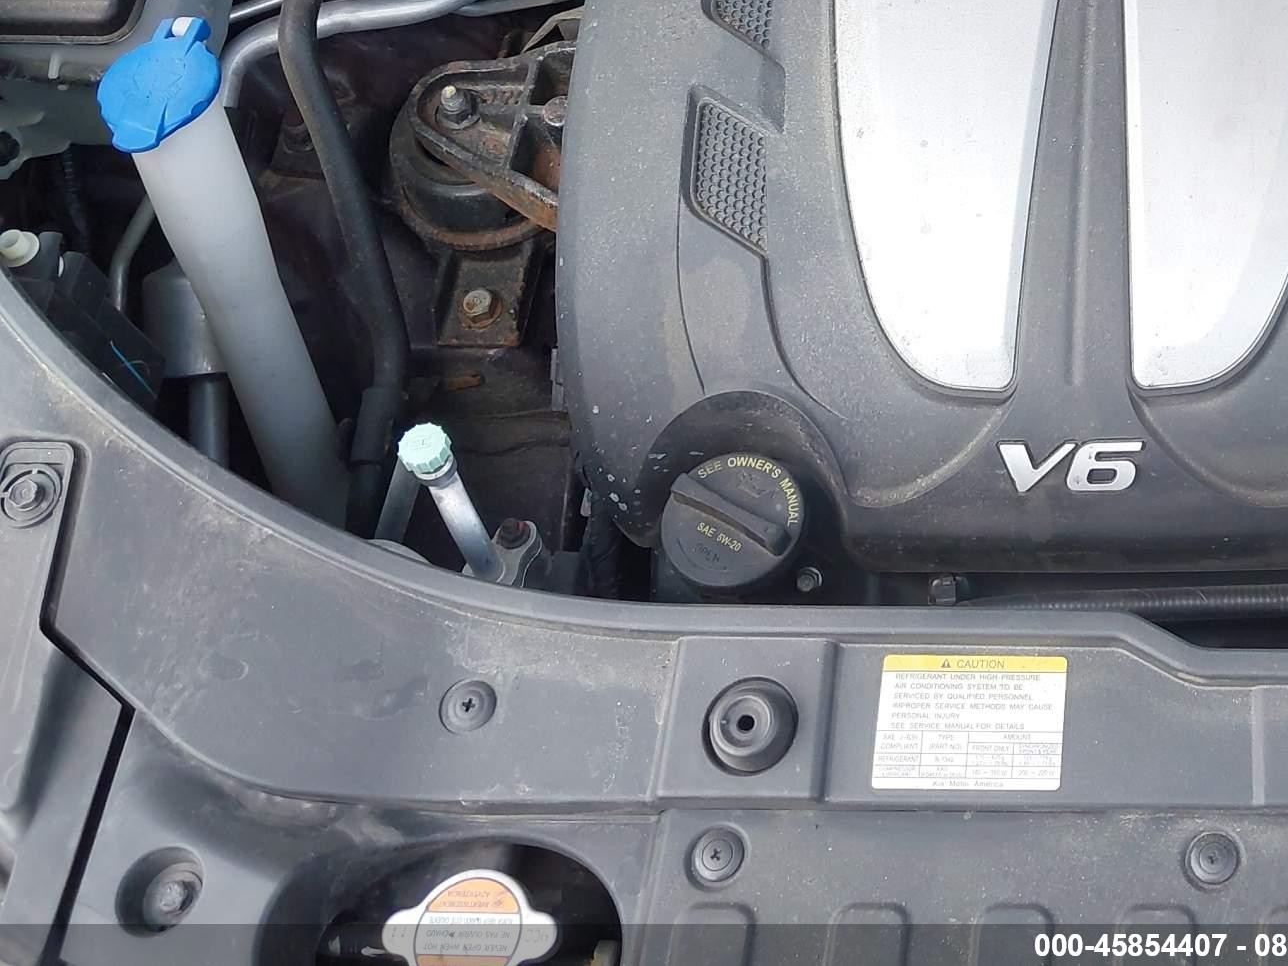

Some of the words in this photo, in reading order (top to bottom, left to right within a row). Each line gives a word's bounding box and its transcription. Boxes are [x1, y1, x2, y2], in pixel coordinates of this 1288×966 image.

[998, 440, 1146, 493] V6
[697, 461, 722, 479] SEE
[727, 456, 782, 479] OWNER'S
[779, 478, 800, 527] MANUAL
[697, 522, 716, 538] SAE
[716, 533, 742, 552] 5W-20
[956, 659, 1004, 670] CAUTION
[896, 673, 946, 681] REFRIGERANT
[910, 682, 964, 690] CONDITIONING
[970, 703, 1006, 711] METHODS
